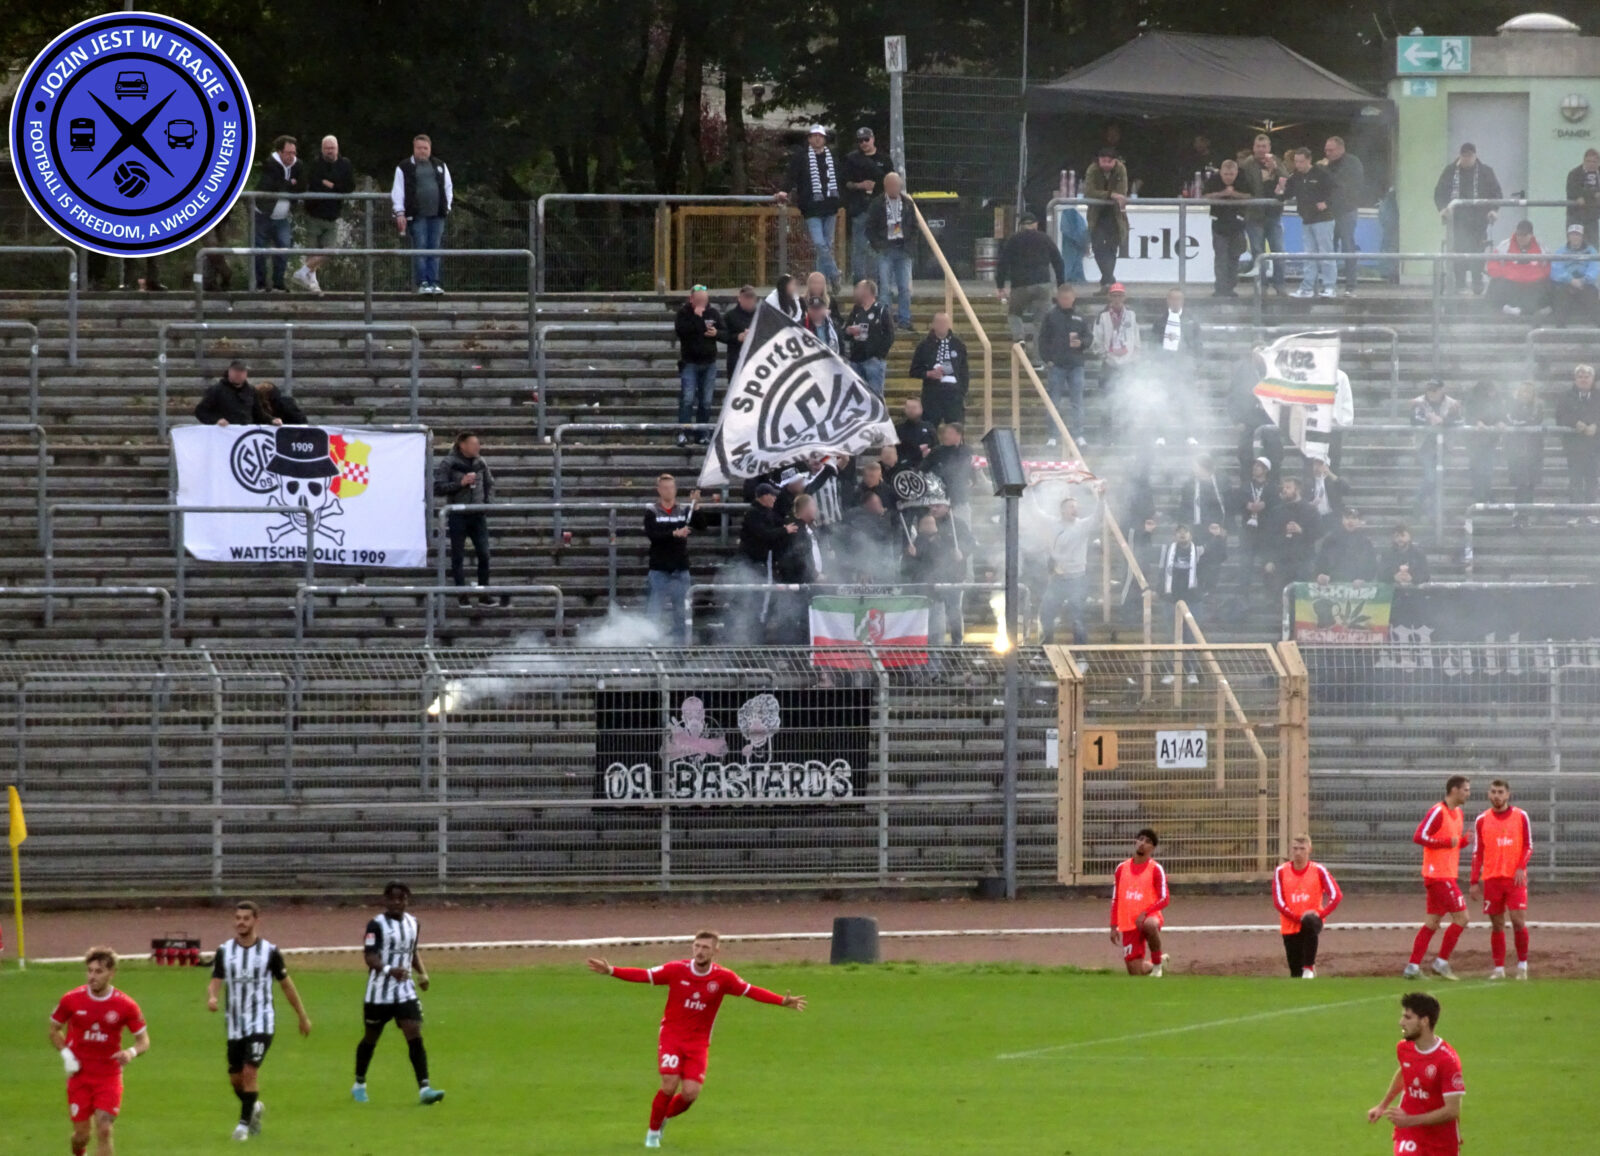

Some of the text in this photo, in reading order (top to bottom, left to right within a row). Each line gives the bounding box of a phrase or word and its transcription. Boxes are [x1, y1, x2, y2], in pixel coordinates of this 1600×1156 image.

[731, 333, 817, 414] Sportge
[291, 442, 314, 453] 1909
[351, 550, 386, 564] 1909
[1093, 736, 1103, 765] 1
[1160, 738, 1204, 760] A1/A2
[670, 759, 853, 799] BASTARDS
[661, 1053, 679, 1068] 20
[1399, 1140, 1417, 1153] 10
